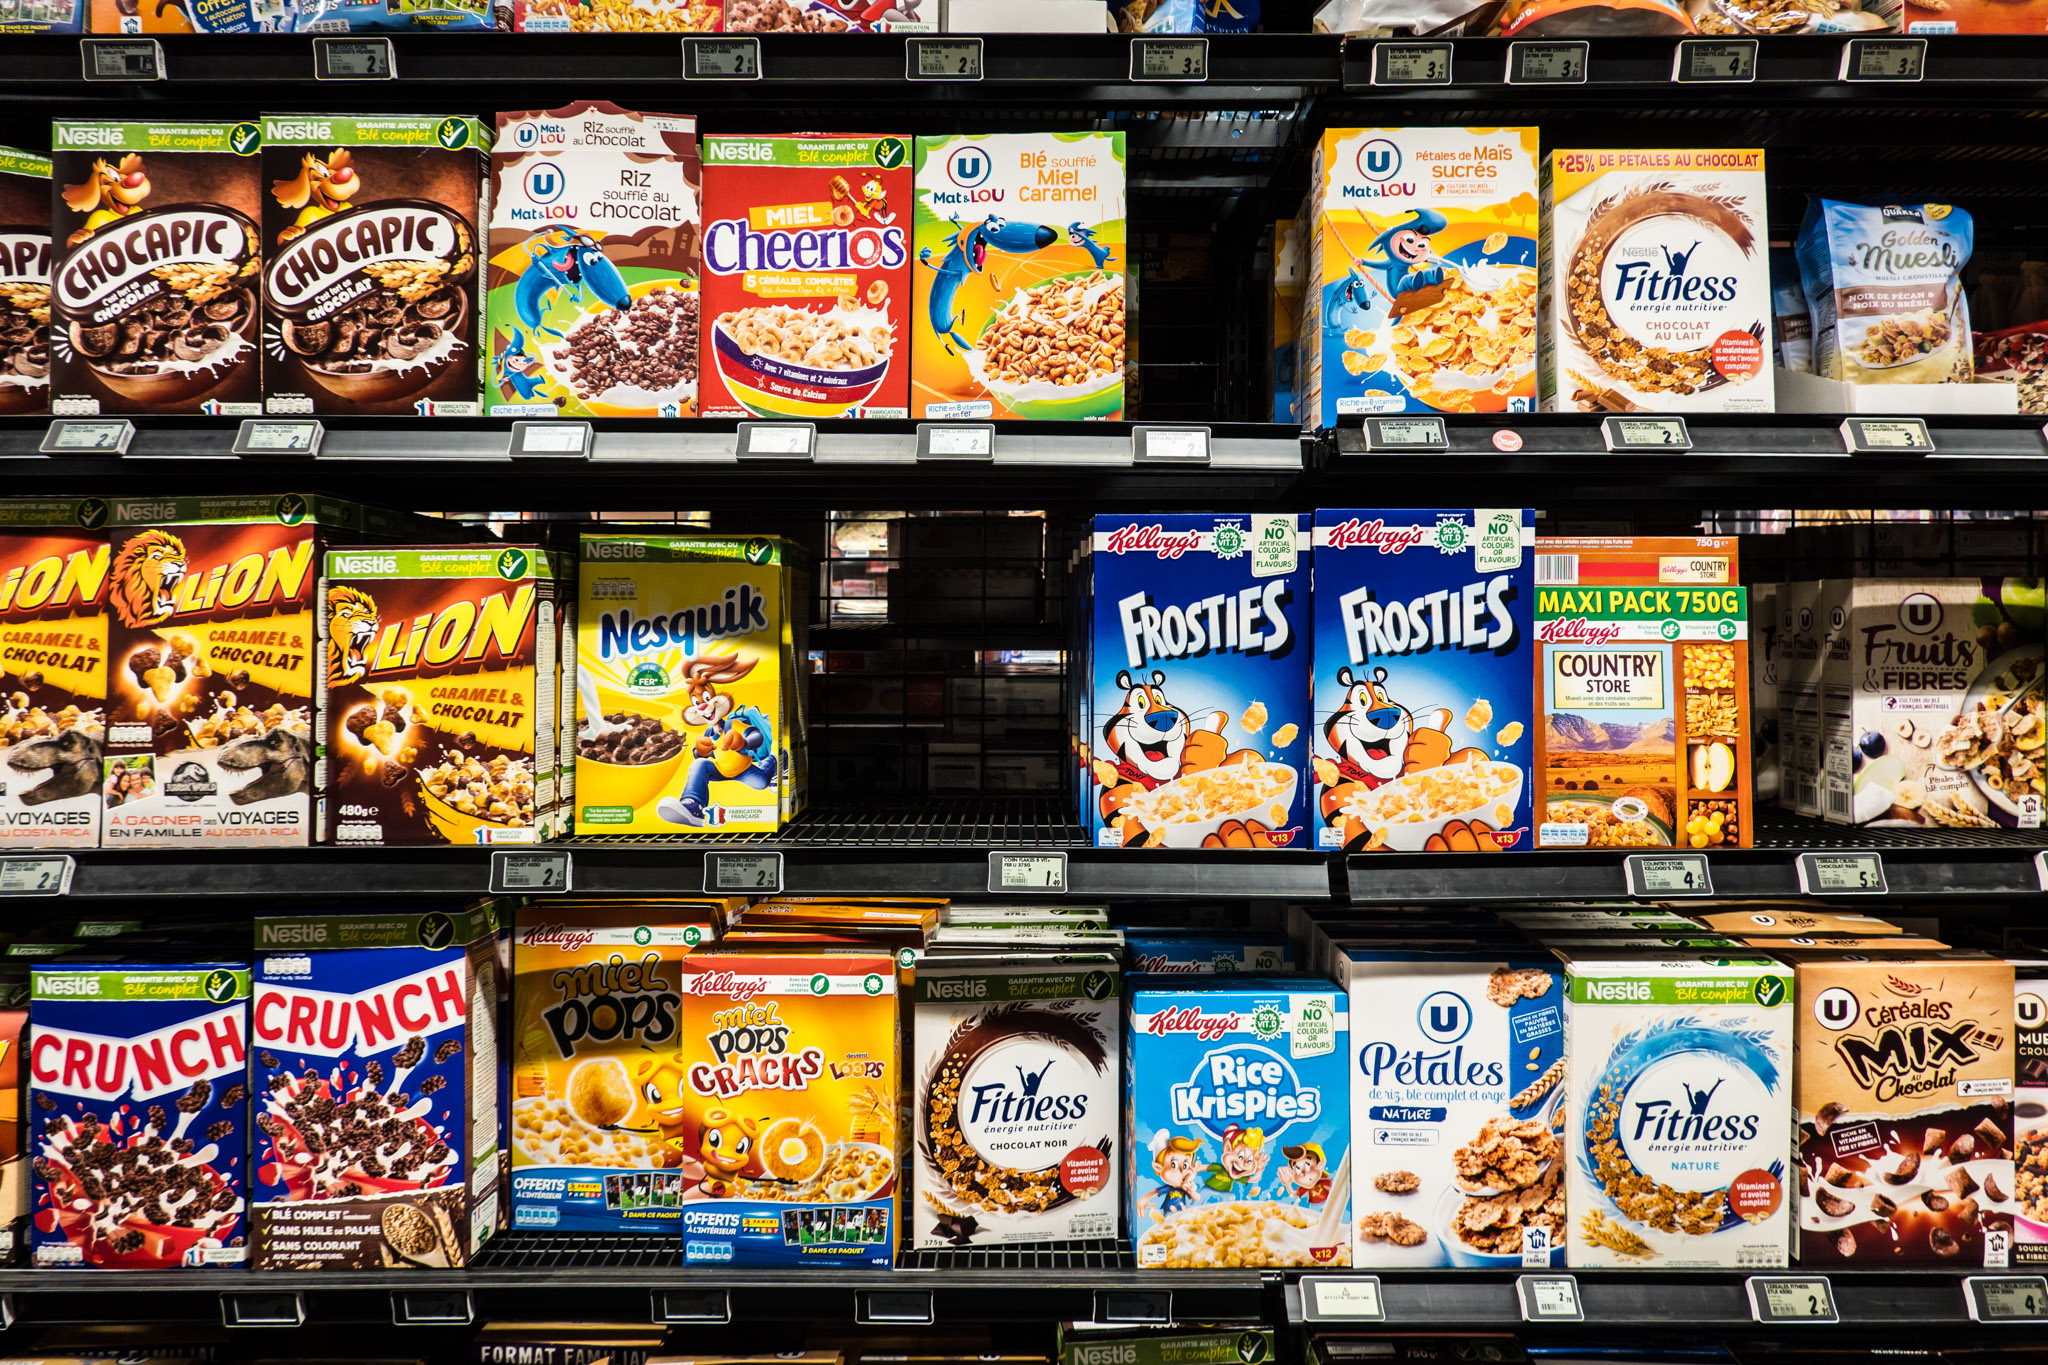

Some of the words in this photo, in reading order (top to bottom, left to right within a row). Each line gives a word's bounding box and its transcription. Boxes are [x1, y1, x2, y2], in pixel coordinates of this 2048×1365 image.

[58, 127, 124, 146] Nestlé
[267, 121, 331, 140] Nestlé
[710, 142, 773, 161] Nestlé
[1021, 151, 1047, 168] Blé
[1051, 155, 1096, 167] soufflé
[1416, 151, 1456, 161] Pétales
[1460, 152, 1471, 160] de
[1474, 145, 1512, 160] Maïs
[958, 158, 980, 178] U
[1368, 151, 1390, 172] U
[1432, 162, 1497, 178] sucrés
[1558, 155, 1594, 172] +25%
[1600, 156, 1614, 166] DE
[1618, 151, 1671, 166] PÉTALES
[1676, 154, 1691, 166] AU
[1696, 153, 1758, 166] CHOCOLAT
[534, 175, 554, 195] U
[620, 170, 651, 187] Riz
[1038, 170, 1078, 185] Miel
[603, 190, 648, 201] soufflé
[653, 192, 669, 202] au
[934, 189, 1004, 204] Mat&LOU
[1019, 186, 1096, 201] Caramel
[1343, 183, 1415, 197] Mat&LOU
[589, 202, 681, 221] Chocolat
[766, 206, 822, 226] MIEL
[706, 220, 905, 270] Cheerios
[1881, 230, 1939, 248] Golden
[65, 219, 228, 300] CHOCAPIC
[275, 215, 438, 298] CHOCAPIC
[1622, 247, 1658, 257] Nestlé
[1856, 241, 1959, 275] Muesli
[747, 275, 756, 287] 5
[759, 275, 801, 285] CÉRÉALES
[805, 276, 854, 285] COMPLÈTES
[1615, 261, 1737, 301] Fitness
[1891, 291, 1925, 300] PÉCAN
[1630, 304, 1671, 313] énergie
[1675, 304, 1723, 312] nutritive
[1646, 322, 1710, 330] CHOCOLAT
[1655, 332, 1671, 341] AU
[1676, 332, 1702, 341] LAIT
[1107, 524, 1200, 559] Kellogg's
[1265, 528, 1284, 539] NO
[1329, 519, 1423, 553] Kellogg's
[336, 556, 397, 573] Nestlé
[177, 541, 314, 614] LION
[1539, 591, 1602, 613] MAXI
[1609, 591, 1671, 613] PACK
[1676, 591, 1739, 613] 750G
[601, 583, 767, 658] Nesquik
[1341, 576, 1513, 664] FROSTIES
[1909, 603, 1936, 625] U
[372, 586, 535, 671] LION
[1119, 580, 1289, 668] FROSTIES
[1541, 618, 1622, 645] Kellogg's
[1863, 625, 1976, 667] Fruits
[1558, 654, 1657, 677] COUNTRY
[1586, 680, 1630, 693] STORE
[1863, 671, 1881, 692] &
[1883, 671, 1968, 691] FIBRES
[431, 687, 507, 705] CARAMEL
[511, 692, 524, 706] &
[432, 704, 523, 728] CHOCOLAT
[110, 814, 123, 825] À
[126, 816, 201, 825] GAGNER
[217, 811, 299, 825] VOYAGES
[110, 829, 131, 837] EN
[134, 829, 202, 837] FAMILLE
[205, 828, 223, 836] AU
[225, 828, 267, 836] COSTA
[271, 828, 299, 836] RICA
[1272, 833, 1288, 842] x13
[524, 925, 594, 950] Kellogg's
[554, 955, 667, 995] miel
[691, 970, 767, 999] Kellogg's
[37, 977, 100, 995] Nestlé
[927, 980, 987, 998] Nestlé
[1587, 982, 1650, 1000] Nestlé
[1675, 989, 1698, 1000] Blé
[1701, 989, 1749, 1003] complet
[255, 968, 465, 1048] CRUNCH
[714, 1003, 781, 1028] miel
[1824, 1000, 1847, 1020] U
[1865, 999, 1952, 1027] Céréales
[1150, 1005, 1241, 1040] Kellogg's
[1431, 1006, 1458, 1032] U
[31, 1015, 245, 1093] CRUNCH
[1838, 1021, 1980, 1088] MIX
[692, 1050, 823, 1095] CRACKS
[829, 1060, 884, 1080] LOOPS
[1212, 1055, 1282, 1087] Rice
[1360, 1042, 1504, 1087] Pétales
[1876, 1067, 1957, 1101] Chocolat
[1911, 1074, 1921, 1082] AU
[970, 1081, 1088, 1124] Fitness
[1177, 1087, 1319, 1120] Krispies
[1369, 1090, 1382, 1099] de
[1385, 1089, 1403, 1101] riz,
[1406, 1088, 1421, 1099] blé
[1424, 1089, 1467, 1102] complet
[1469, 1089, 1479, 1099] et
[1481, 1091, 1506, 1102] orge
[1382, 1108, 1432, 1120] NATURE
[1634, 1099, 1759, 1142] Fitness
[990, 1141, 1041, 1150] CHOCOLAT
[1044, 1139, 1068, 1149] NOIR
[1839, 1134, 1873, 1146] VITAMINES,
[1671, 1160, 1720, 1171] NATURE
[1770, 1182, 1775, 1190] B
[1740, 1199, 1770, 1207] complète
[684, 1212, 740, 1226] OFFERTS
[272, 1226, 300, 1235] SANS
[302, 1226, 333, 1235] HUILE
[345, 1226, 380, 1235] PALME
[924, 1239, 943, 1247] 375g
[1315, 1249, 1332, 1259] x12
[481, 1347, 555, 1364] FORMAT
[1074, 1346, 1136, 1365] Nestlé
